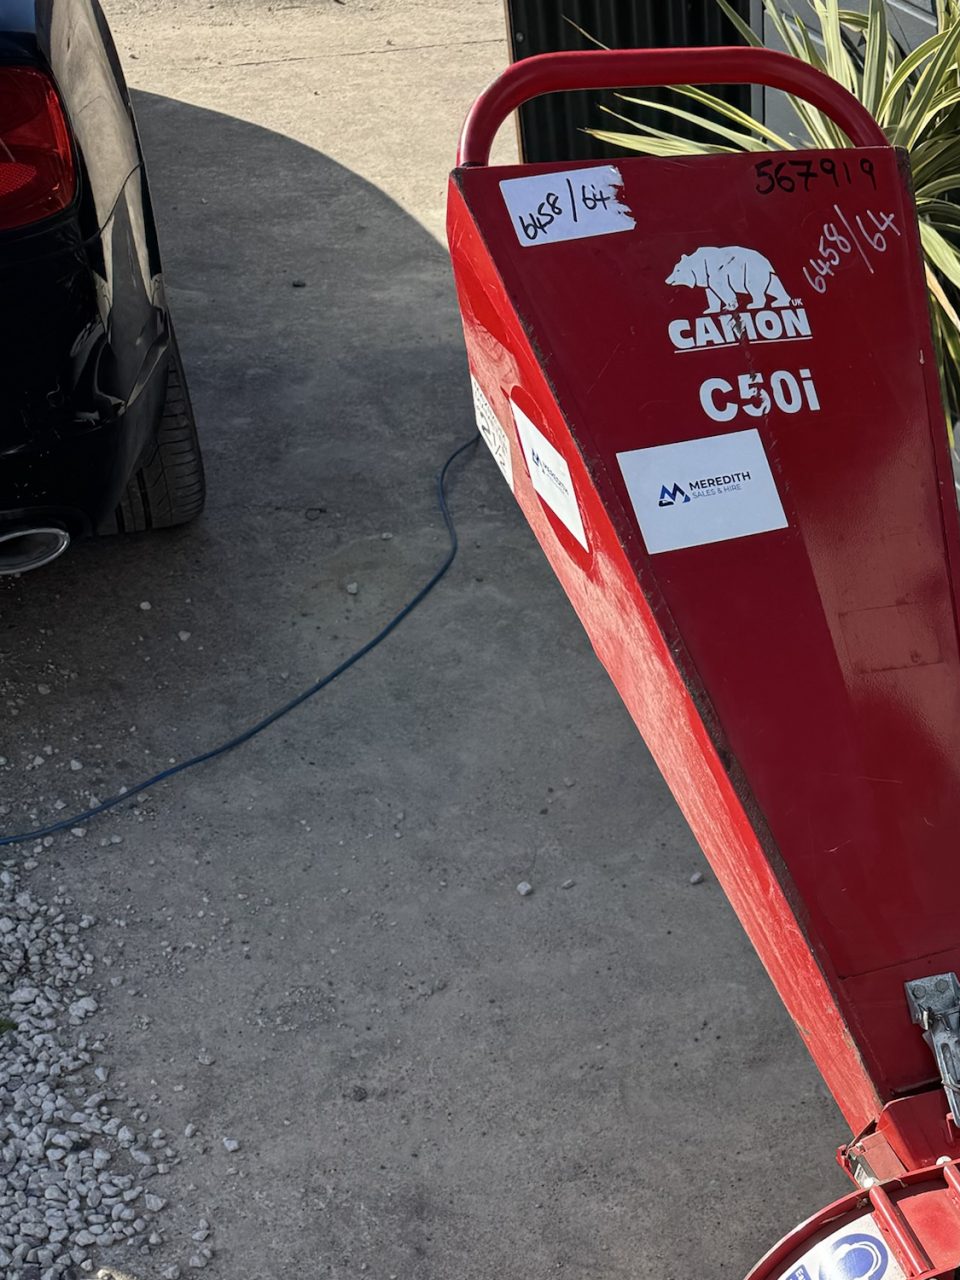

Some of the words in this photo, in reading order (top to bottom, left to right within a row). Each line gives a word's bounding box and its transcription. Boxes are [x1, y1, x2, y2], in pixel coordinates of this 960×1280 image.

[754, 158, 877, 194] 567919
[519, 178, 611, 240] 6458/64
[802, 204, 901, 294] 6458/64
[668, 308, 812, 349] CAMON
[699, 368, 821, 422] C50i
[689, 471, 751, 491] MEREDITH
[692, 489, 716, 499] SALES
[723, 484, 742, 494] HIRE
